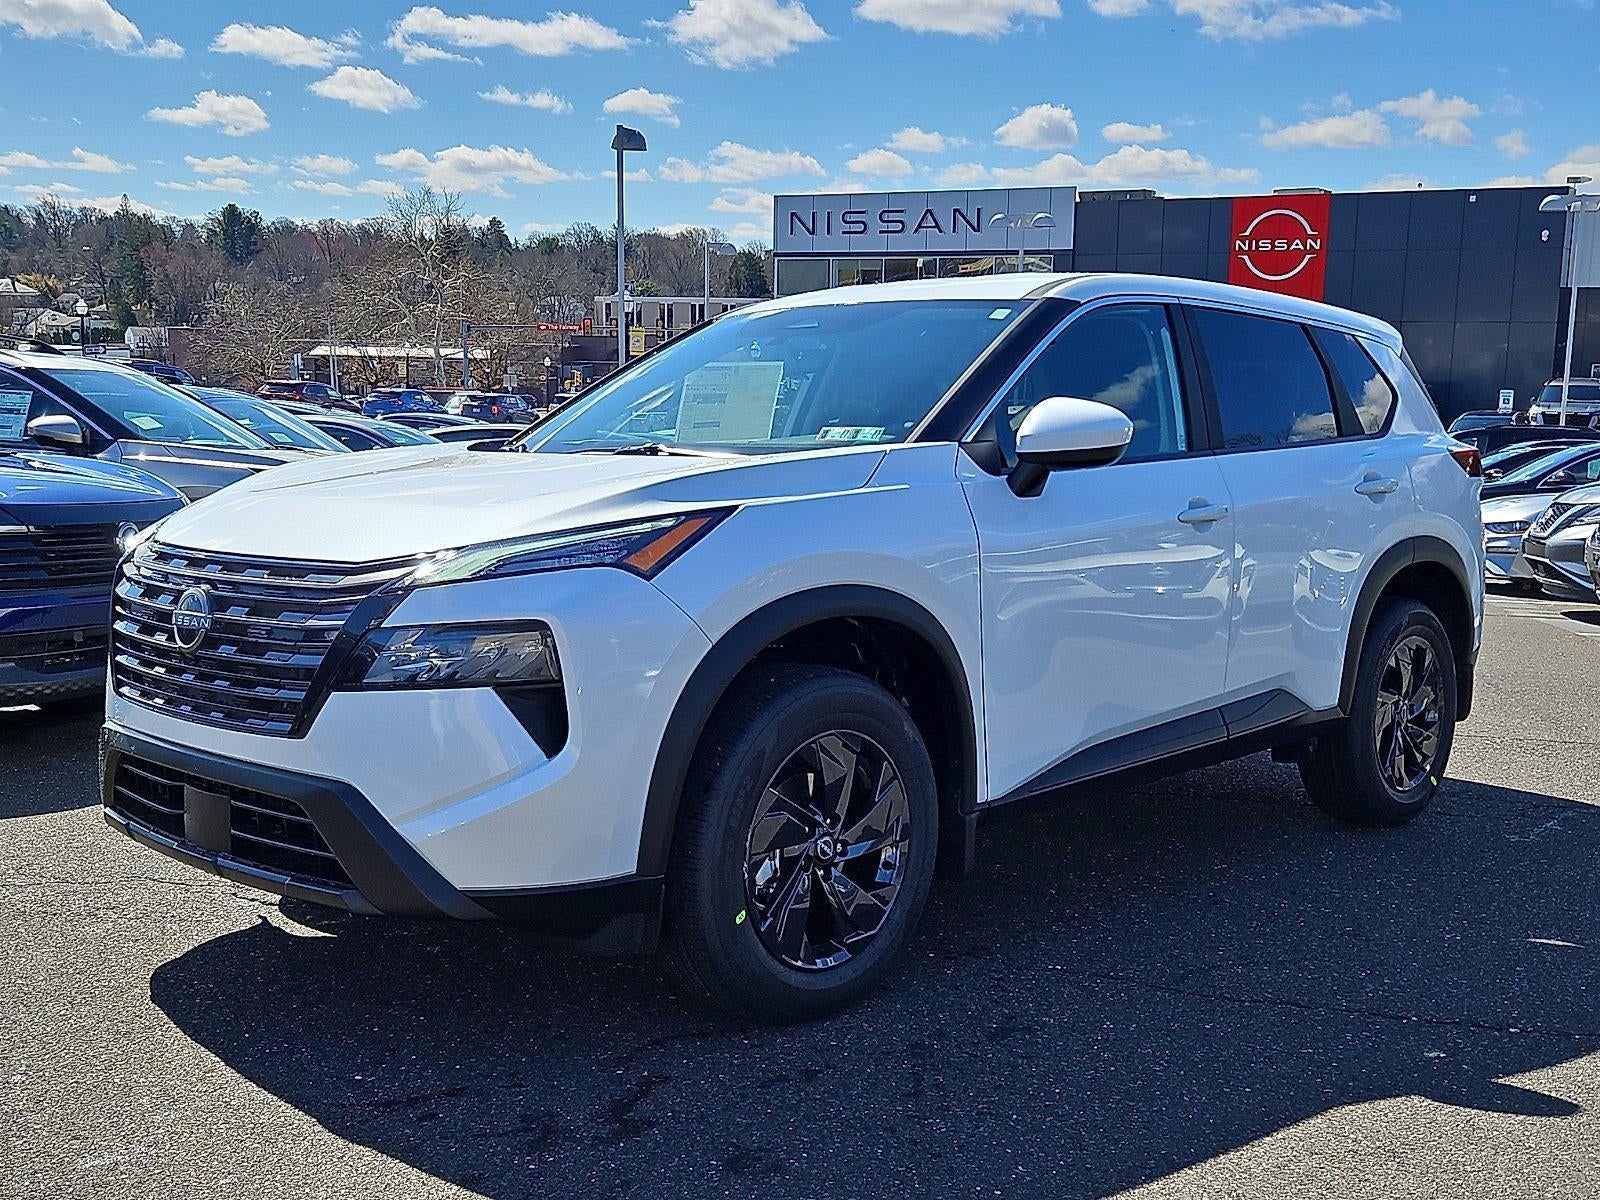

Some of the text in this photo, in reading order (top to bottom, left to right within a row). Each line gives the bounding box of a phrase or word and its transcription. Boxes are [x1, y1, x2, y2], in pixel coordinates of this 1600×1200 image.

[789, 207, 983, 236] NISSAN
[1235, 239, 1320, 250] NISSAN
[173, 614, 209, 628] SSAN
